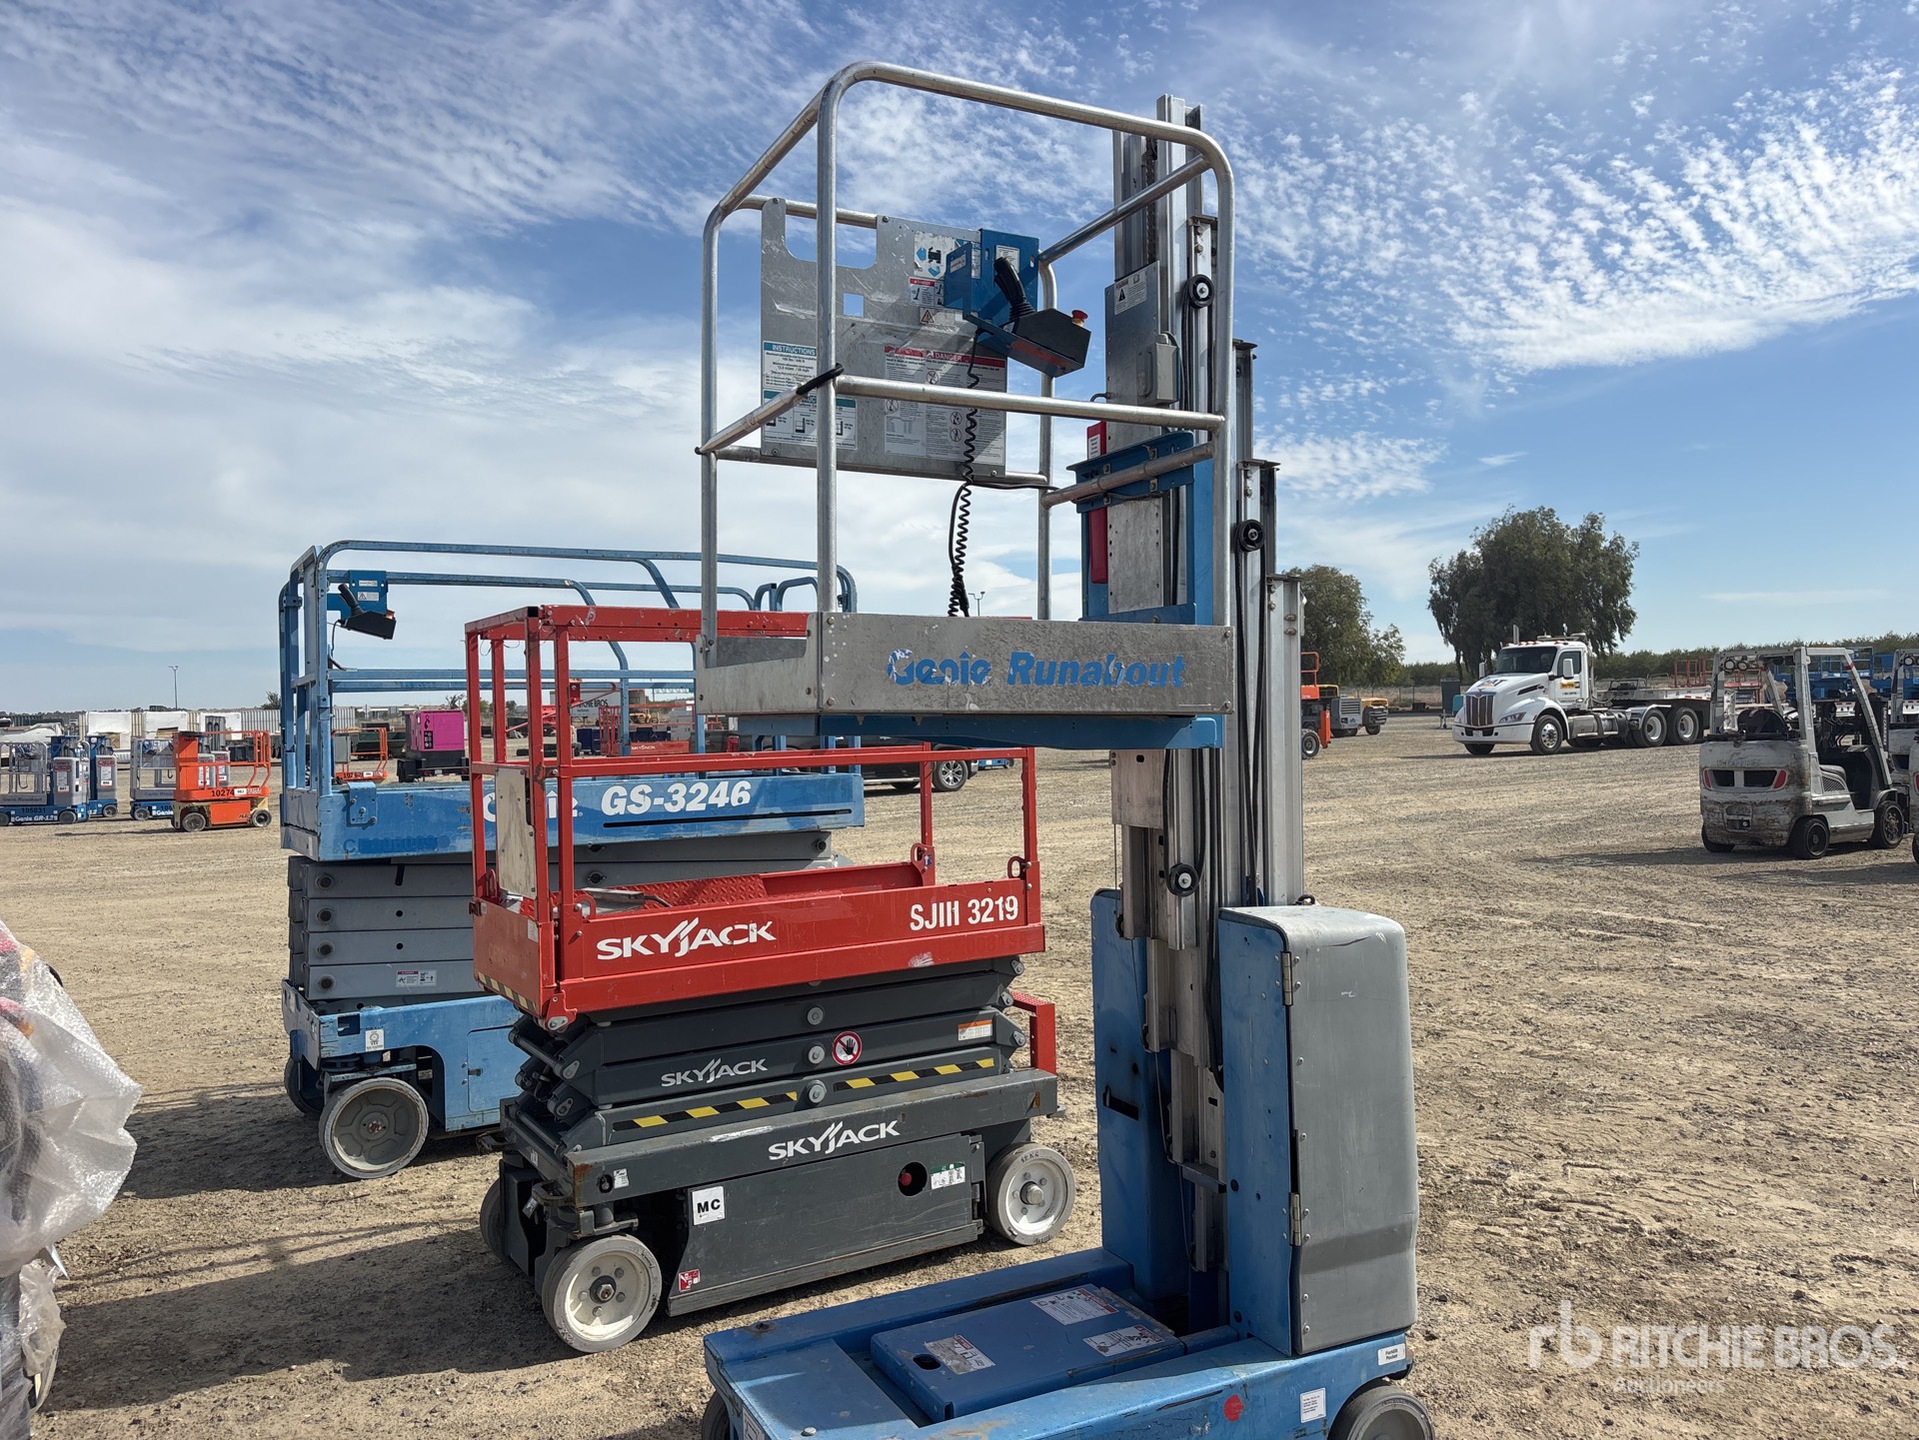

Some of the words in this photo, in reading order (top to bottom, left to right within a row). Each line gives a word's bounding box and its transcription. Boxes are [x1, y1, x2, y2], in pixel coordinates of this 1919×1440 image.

[772, 344, 816, 356] INSTRUCTIONS
[935, 352, 963, 361] DANGER
[886, 648, 992, 686] Genie
[1006, 651, 1187, 688] Runabout
[601, 780, 752, 816] GS-3246
[967, 895, 1019, 925] 3219
[596, 916, 777, 960] SKYJACK
[661, 1058, 768, 1087] SKYJACK
[768, 1120, 901, 1160] SKYJACK
[697, 1199, 721, 1214] MC
